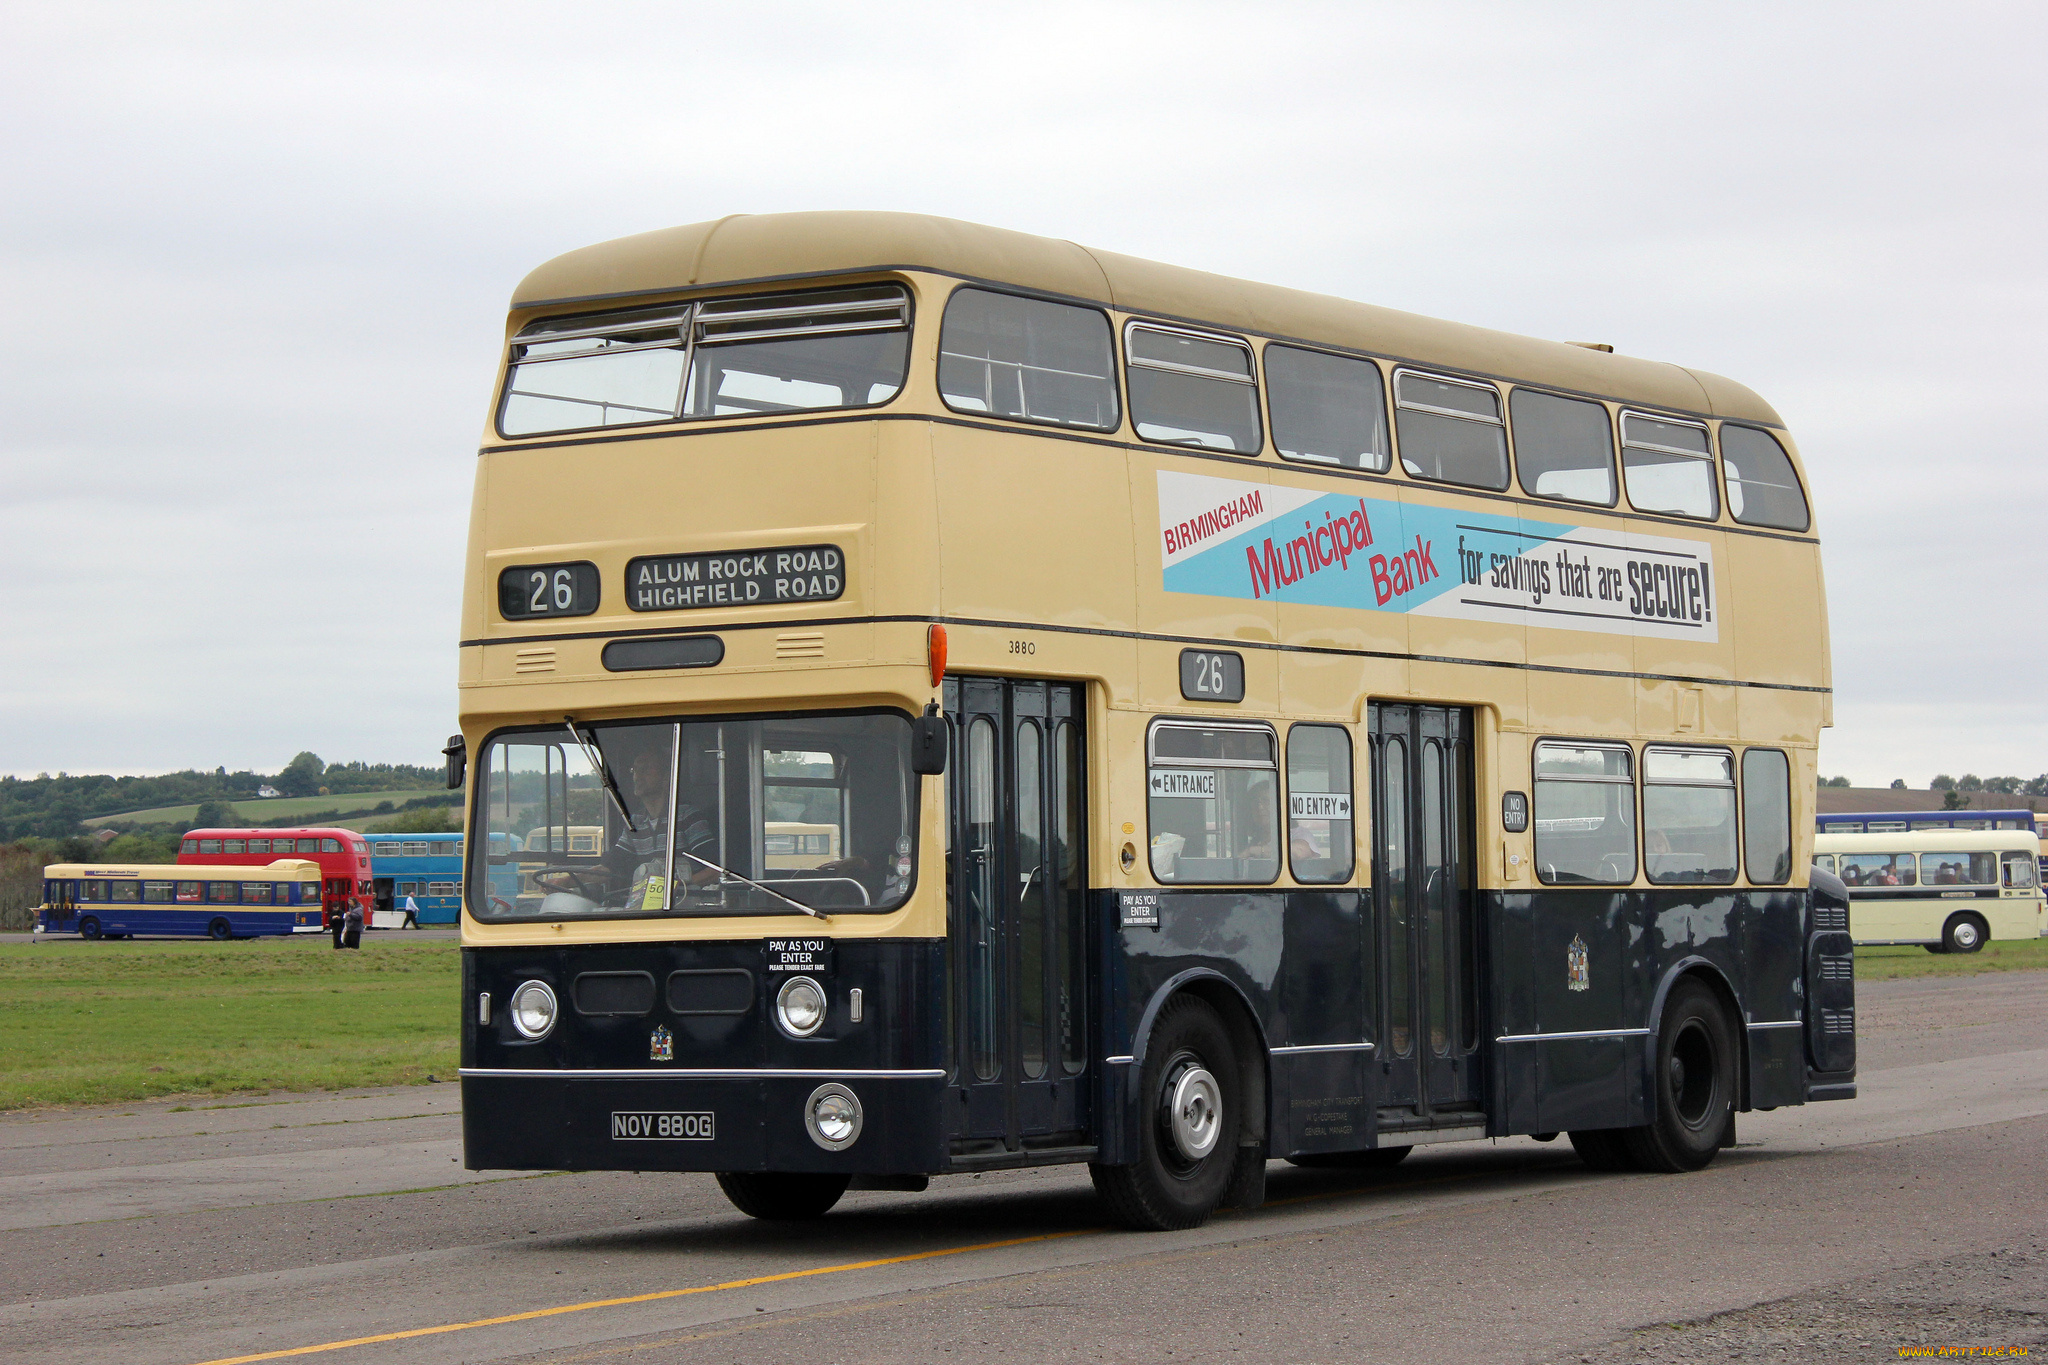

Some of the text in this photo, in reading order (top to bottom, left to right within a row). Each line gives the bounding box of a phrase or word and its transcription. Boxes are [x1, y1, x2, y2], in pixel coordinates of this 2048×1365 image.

[1164, 490, 1263, 555] BIRMINGHAM
[1246, 498, 1374, 599] Municipal
[638, 549, 839, 585] ALUM ROCK ROAD
[1370, 534, 1439, 607] Bank
[1458, 535, 1711, 622] for savings that are secure!
[530, 569, 573, 612] 26
[638, 574, 840, 607] HIGHFIELD ROAD
[1009, 641, 1036, 655] 3880
[1195, 653, 1223, 694] 26
[1163, 775, 1214, 794] ENTRANCE
[1292, 796, 1338, 816] NO ENTRY
[1510, 798, 1520, 810] NO
[1505, 811, 1525, 825] ENTRY
[1123, 895, 1157, 905] PAY AS YOU
[1131, 906, 1150, 916] ENTER
[769, 941, 824, 951] PAY AS YOU
[781, 952, 812, 963] ENTER
[1323, 1097, 1334, 1107] CITY
[1336, 1096, 1363, 1106] TRANSPORT
[614, 1115, 712, 1137] NOV 880G
[1305, 1126, 1353, 1136] GENERAL MANAGER
